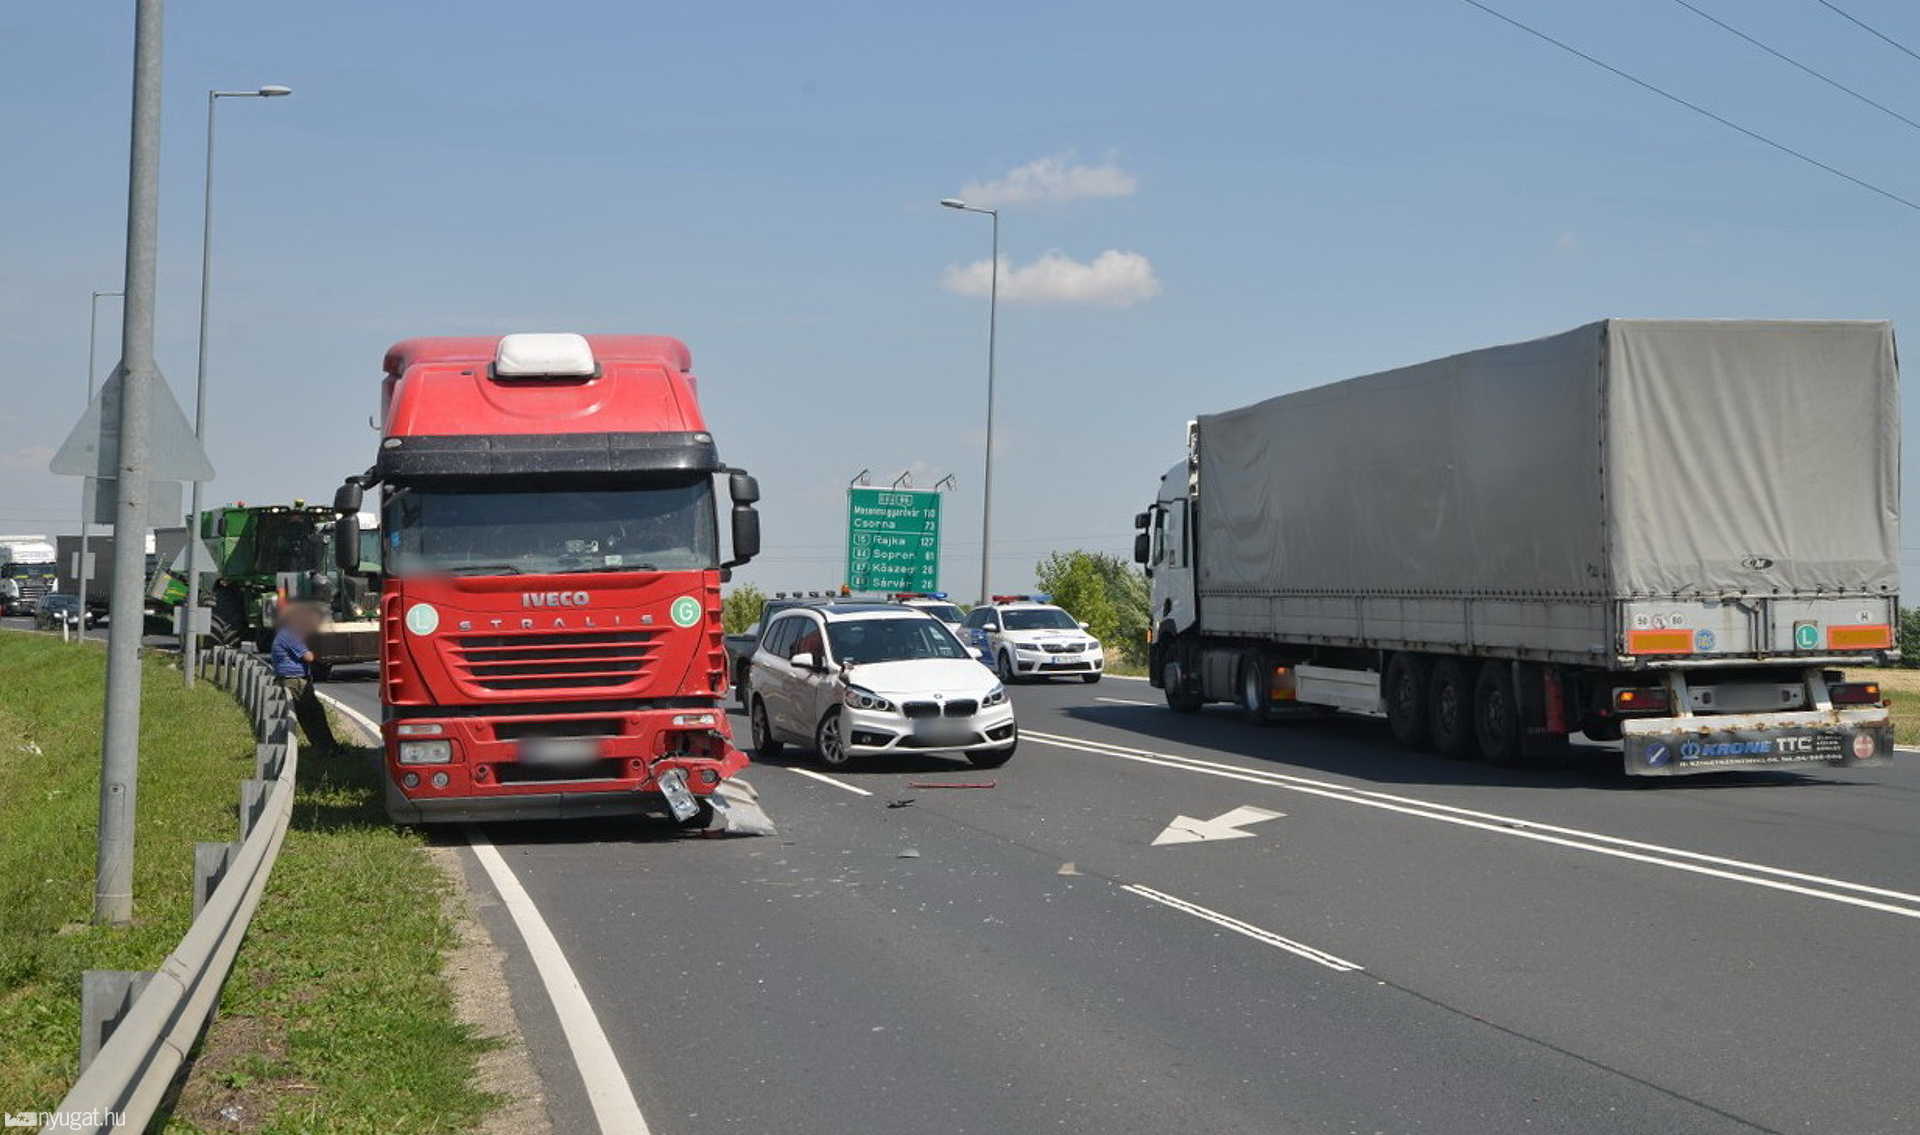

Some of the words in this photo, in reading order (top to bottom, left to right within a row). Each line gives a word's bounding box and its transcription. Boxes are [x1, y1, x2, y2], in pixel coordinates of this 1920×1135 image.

[854, 518, 896, 529] Csorna
[873, 535, 906, 547] Rajka
[921, 537, 935, 546] 127
[522, 591, 590, 607] IVECO
[416, 611, 429, 628] L
[679, 602, 695, 621] G
[458, 614, 653, 632] STRALIS
[1802, 628, 1813, 646] L
[1702, 740, 1772, 756] KRONE
[1776, 736, 1813, 752] TTC
